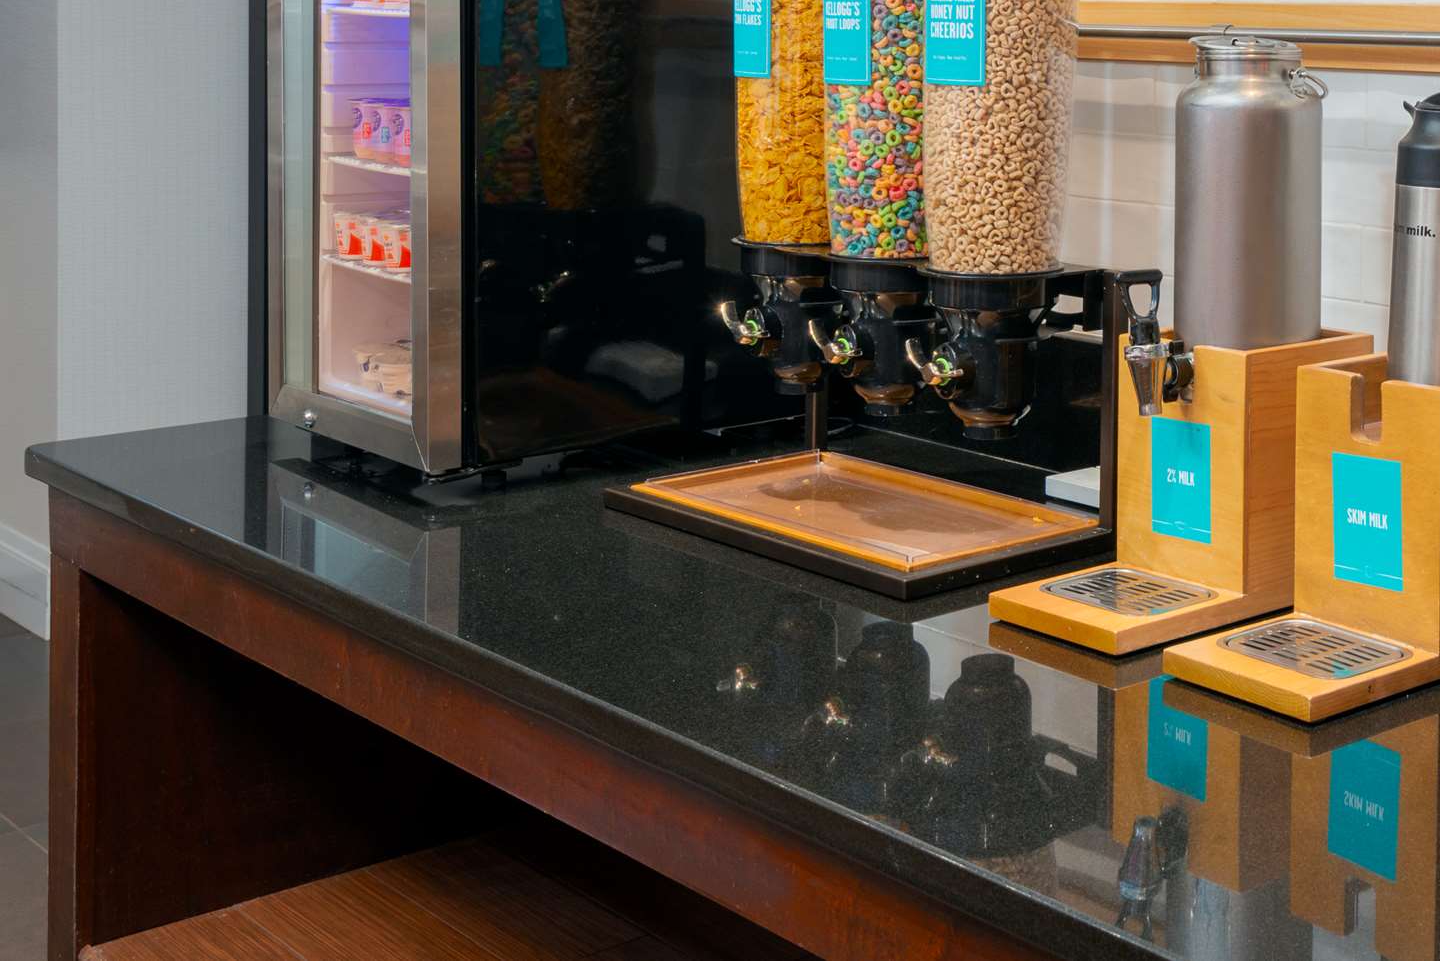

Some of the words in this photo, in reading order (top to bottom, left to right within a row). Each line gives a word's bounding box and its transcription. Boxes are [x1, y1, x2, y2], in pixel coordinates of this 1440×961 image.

[955, 4, 976, 21] NUT
[839, 17, 861, 31] LOOPS
[930, 21, 975, 40] CHEERIOS
[1406, 225, 1436, 238] milk.
[1166, 467, 1177, 484] 2%
[1178, 470, 1195, 488] MILK
[1346, 507, 1367, 526] SKIM
[1368, 511, 1389, 530] MILK
